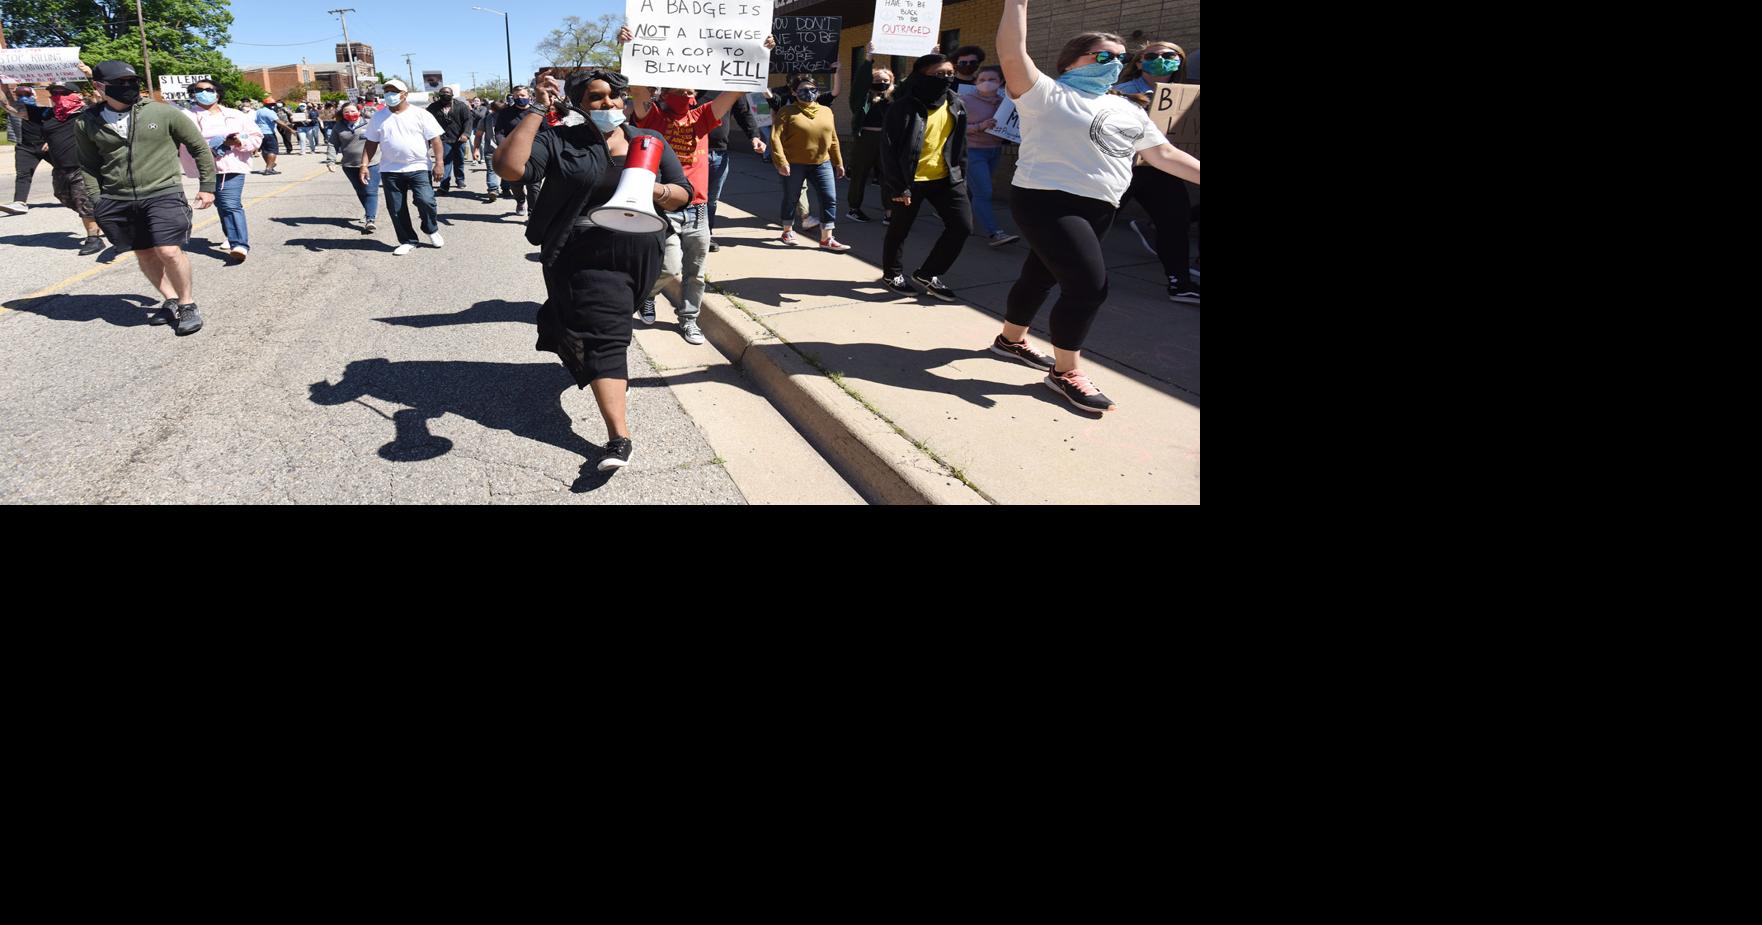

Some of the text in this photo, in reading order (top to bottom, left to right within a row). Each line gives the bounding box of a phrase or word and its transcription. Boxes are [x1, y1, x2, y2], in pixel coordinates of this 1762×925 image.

[641, 0, 653, 12] A
[667, 0, 726, 18] BADGE
[738, 4, 761, 16] IS
[796, 17, 838, 30] DON'T
[882, 24, 931, 35] OUTRAGED
[635, 24, 761, 40] NOT A LICENSE
[797, 31, 816, 43] TO
[819, 31, 839, 43] BE
[632, 44, 744, 57] FOR A COP TO
[775, 45, 812, 56] BLACK
[783, 52, 795, 61] TO
[645, 60, 766, 79] BLINDLY KILL
[160, 74, 211, 84] SILENCE
